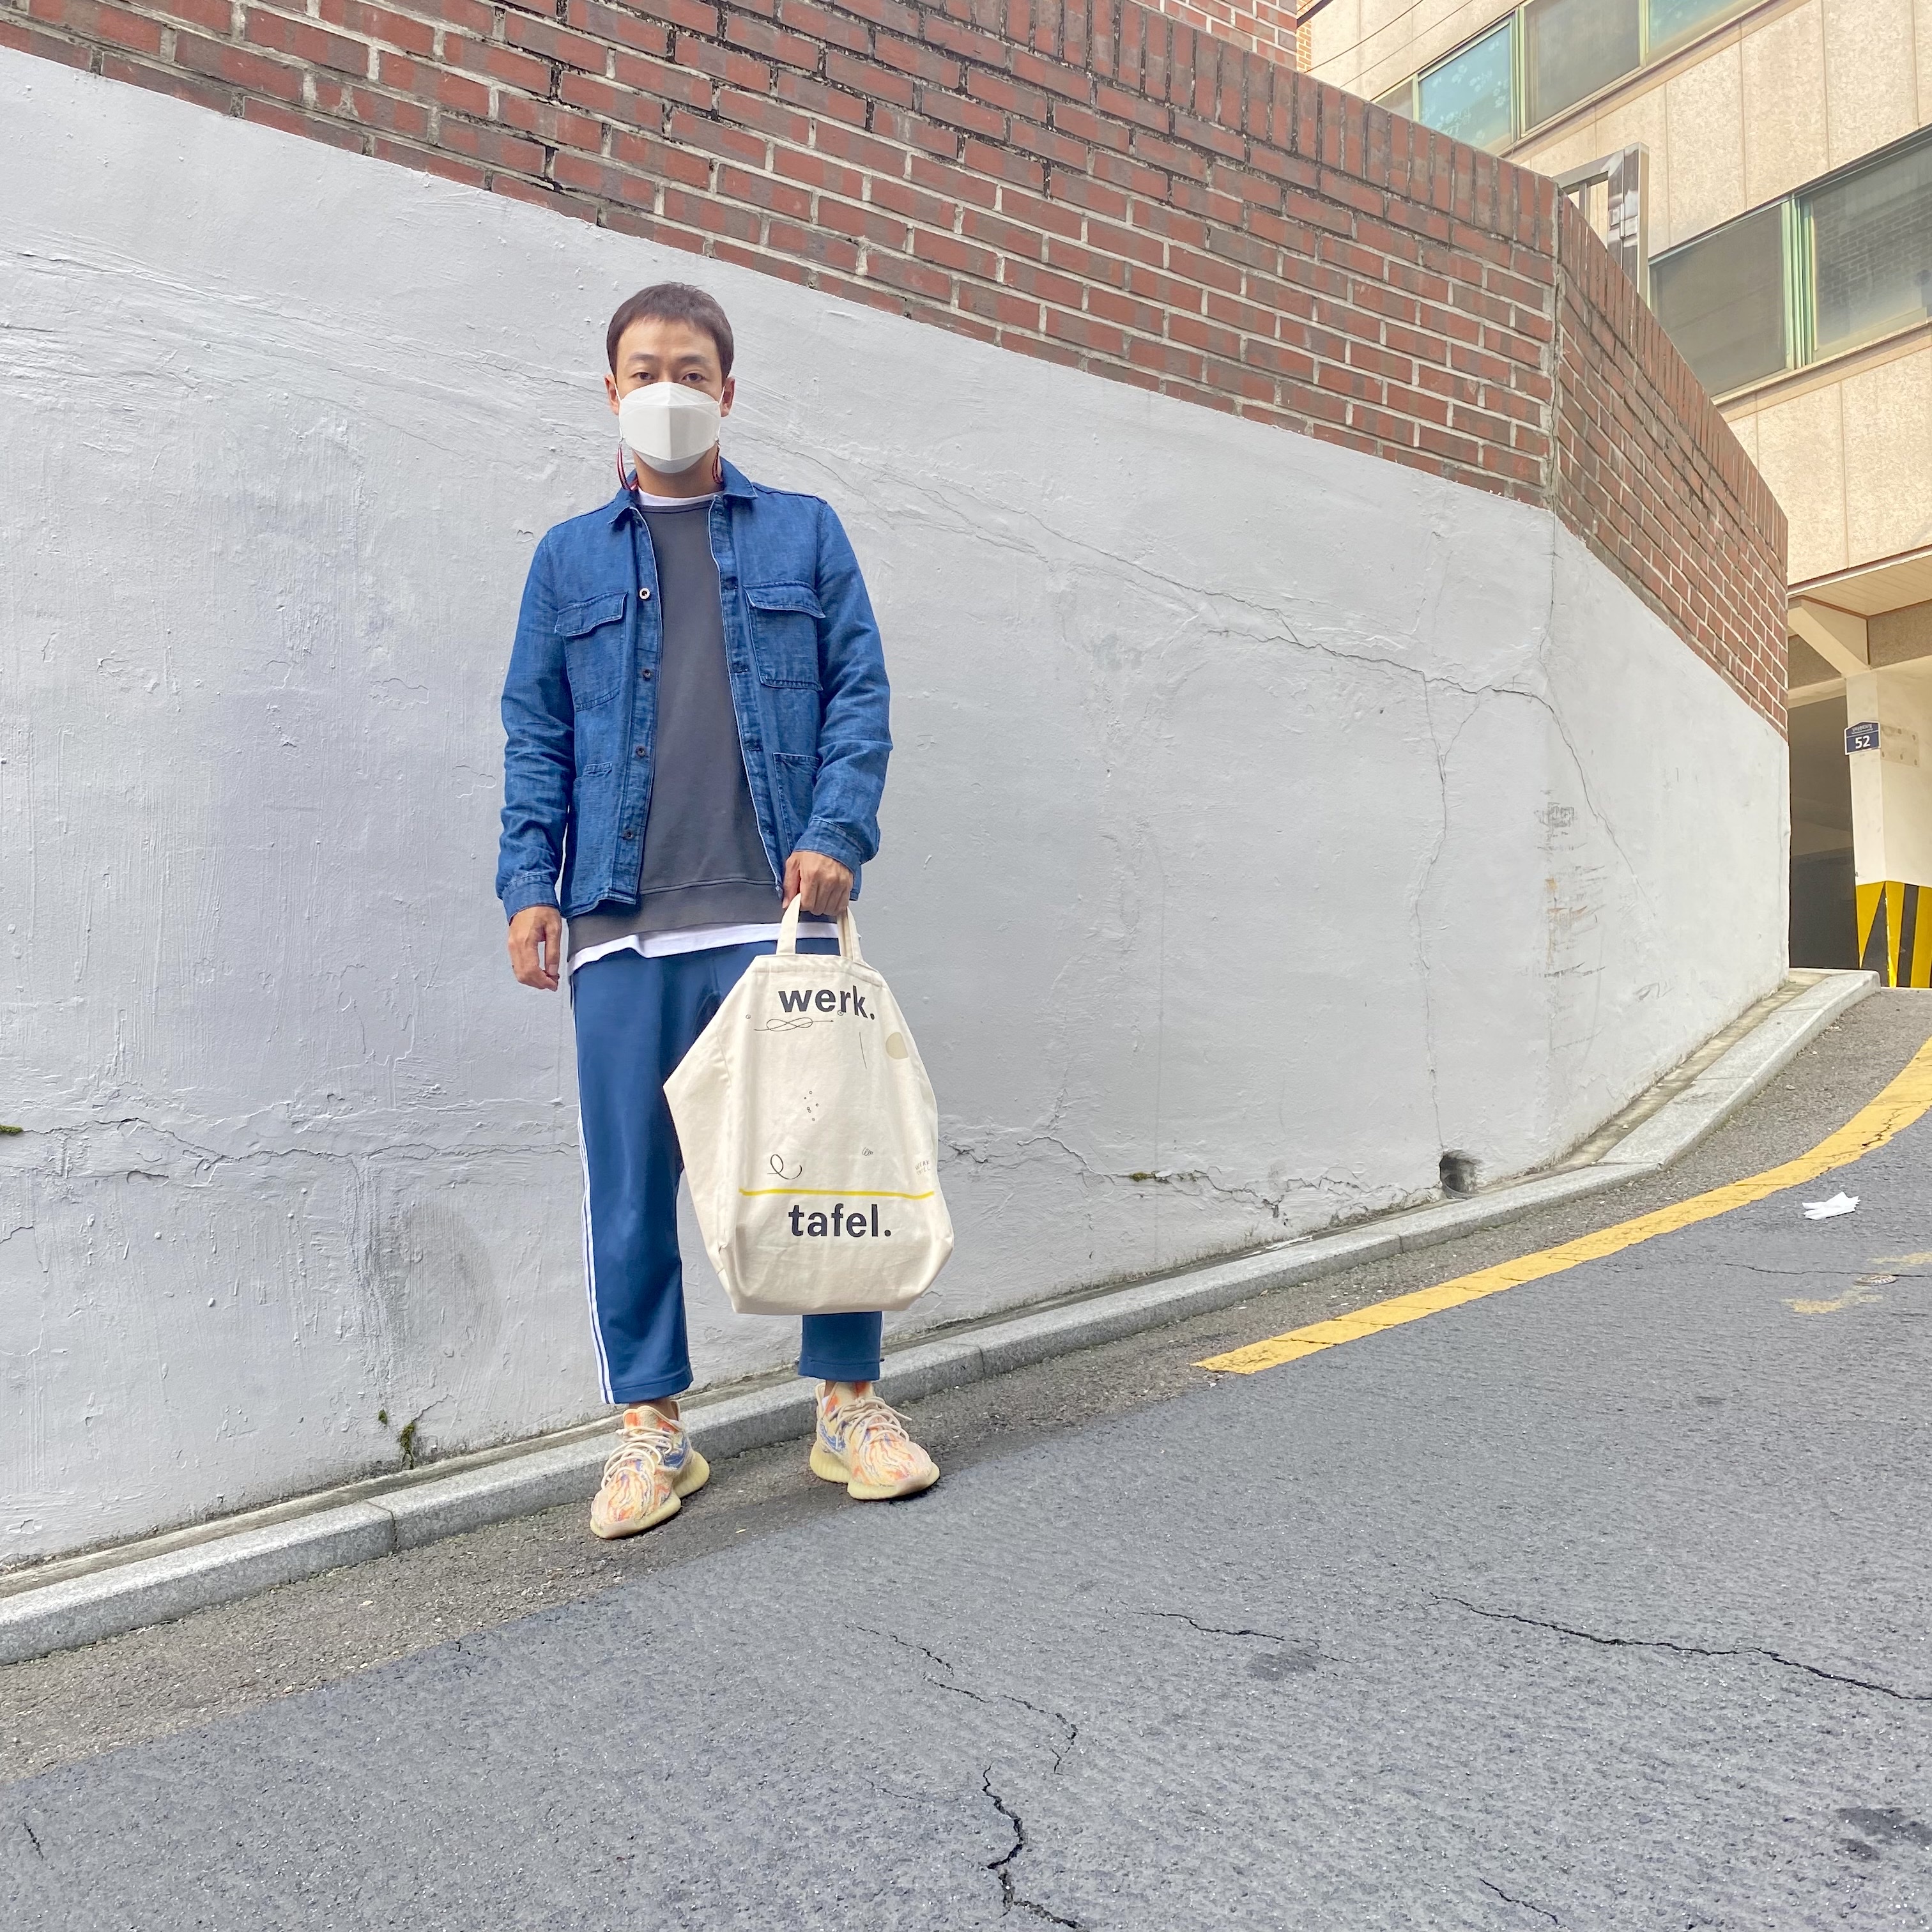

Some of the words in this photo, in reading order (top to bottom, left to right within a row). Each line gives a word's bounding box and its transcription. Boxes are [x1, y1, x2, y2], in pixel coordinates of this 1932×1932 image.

[1855, 735, 1871, 749] 52
[778, 985, 875, 1020] werk.
[788, 1203, 891, 1238] tafel.
